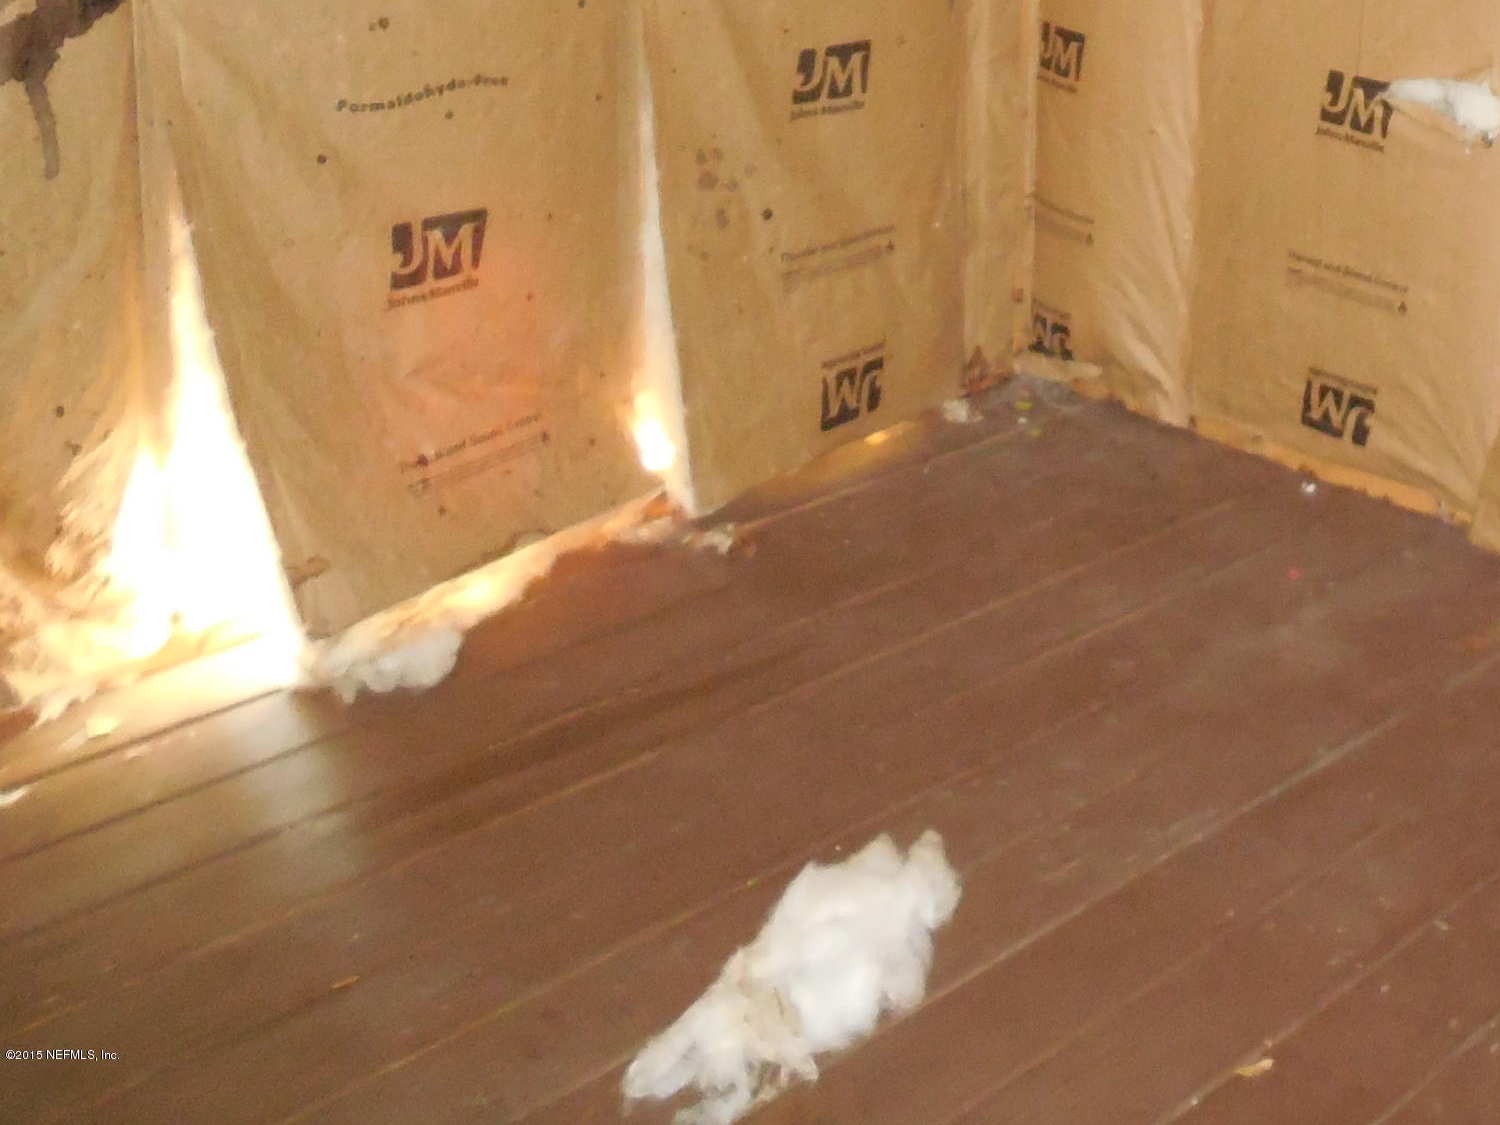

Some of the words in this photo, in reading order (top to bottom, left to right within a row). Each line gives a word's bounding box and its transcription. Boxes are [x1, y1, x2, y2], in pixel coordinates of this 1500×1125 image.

[792, 39, 872, 105] JM
[1320, 69, 1394, 140] JM
[390, 207, 488, 291] JM
